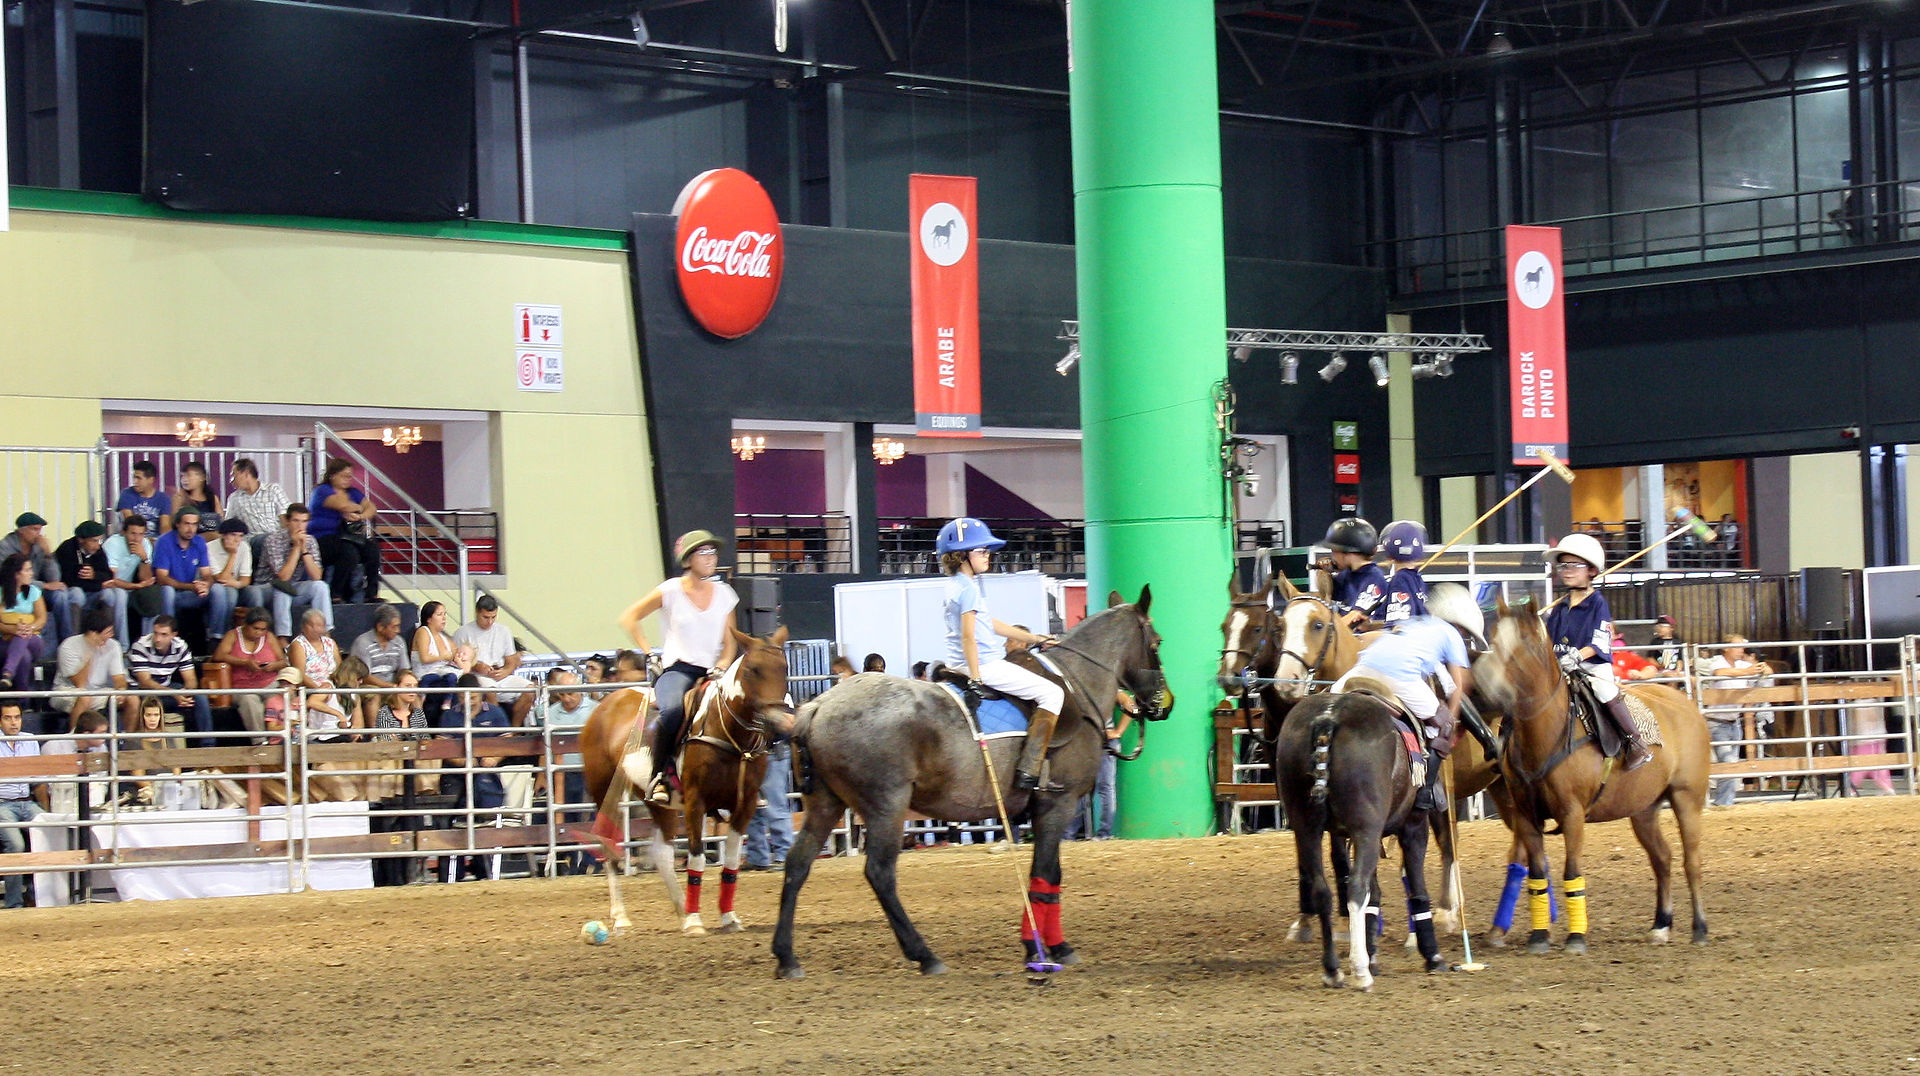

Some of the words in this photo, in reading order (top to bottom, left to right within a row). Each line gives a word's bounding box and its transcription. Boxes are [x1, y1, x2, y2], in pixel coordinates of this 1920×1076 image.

[682, 226, 776, 278] Coca-Cola
[937, 327, 955, 388] ARABE
[1520, 351, 1535, 418] BAROCK
[1539, 368, 1555, 418] PINTO
